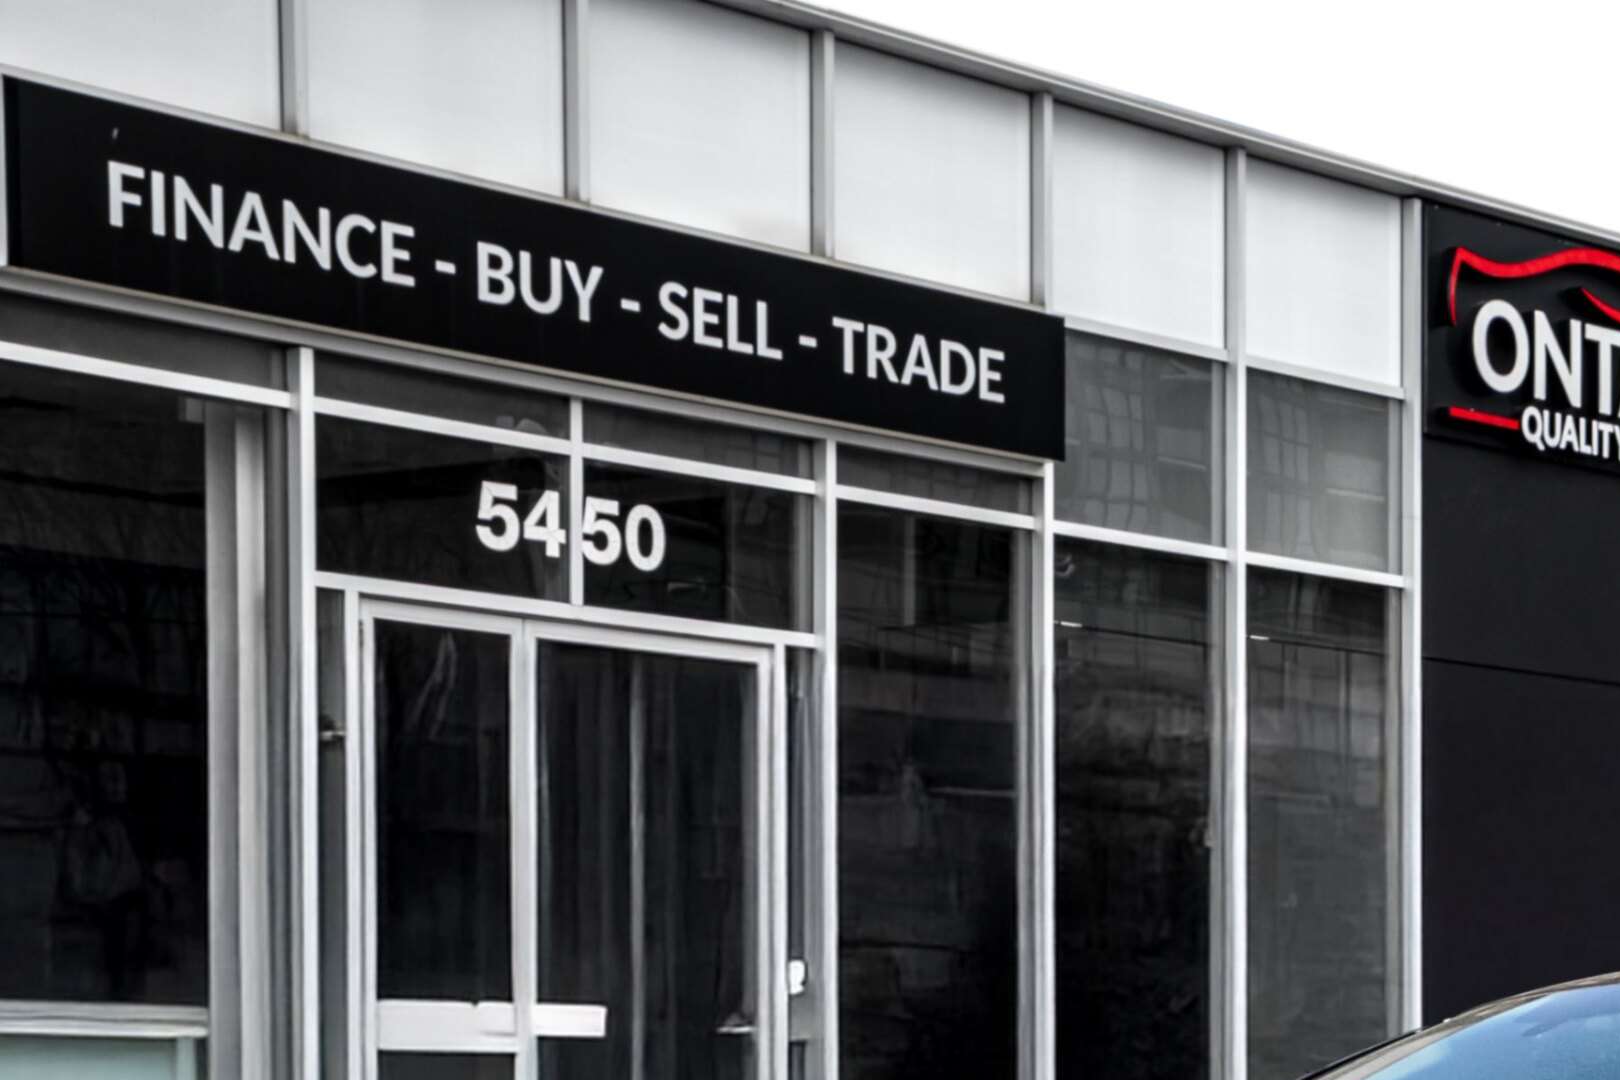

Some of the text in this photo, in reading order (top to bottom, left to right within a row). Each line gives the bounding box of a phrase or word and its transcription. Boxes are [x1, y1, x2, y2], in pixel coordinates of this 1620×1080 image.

[107, 160, 416, 288] FINANCE
[476, 241, 604, 323] BUY
[657, 280, 783, 360] SELL
[831, 315, 1006, 404] TRADE
[474, 479, 667, 573] 5450
